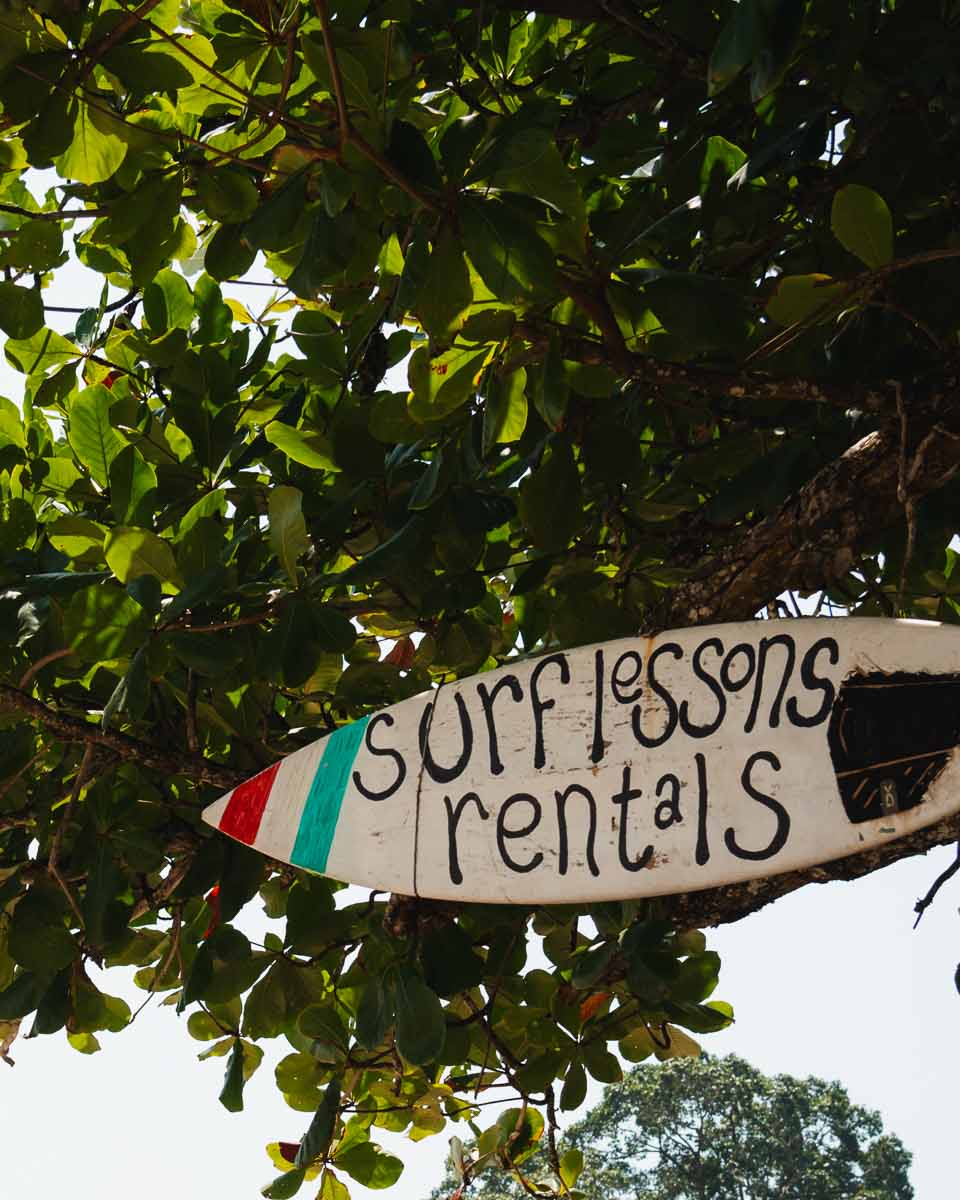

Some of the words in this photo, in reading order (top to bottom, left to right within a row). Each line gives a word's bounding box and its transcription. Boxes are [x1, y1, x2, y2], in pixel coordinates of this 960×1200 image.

[352, 652, 571, 802] surf
[588, 633, 840, 764] lessons
[443, 750, 792, 885] rentals
